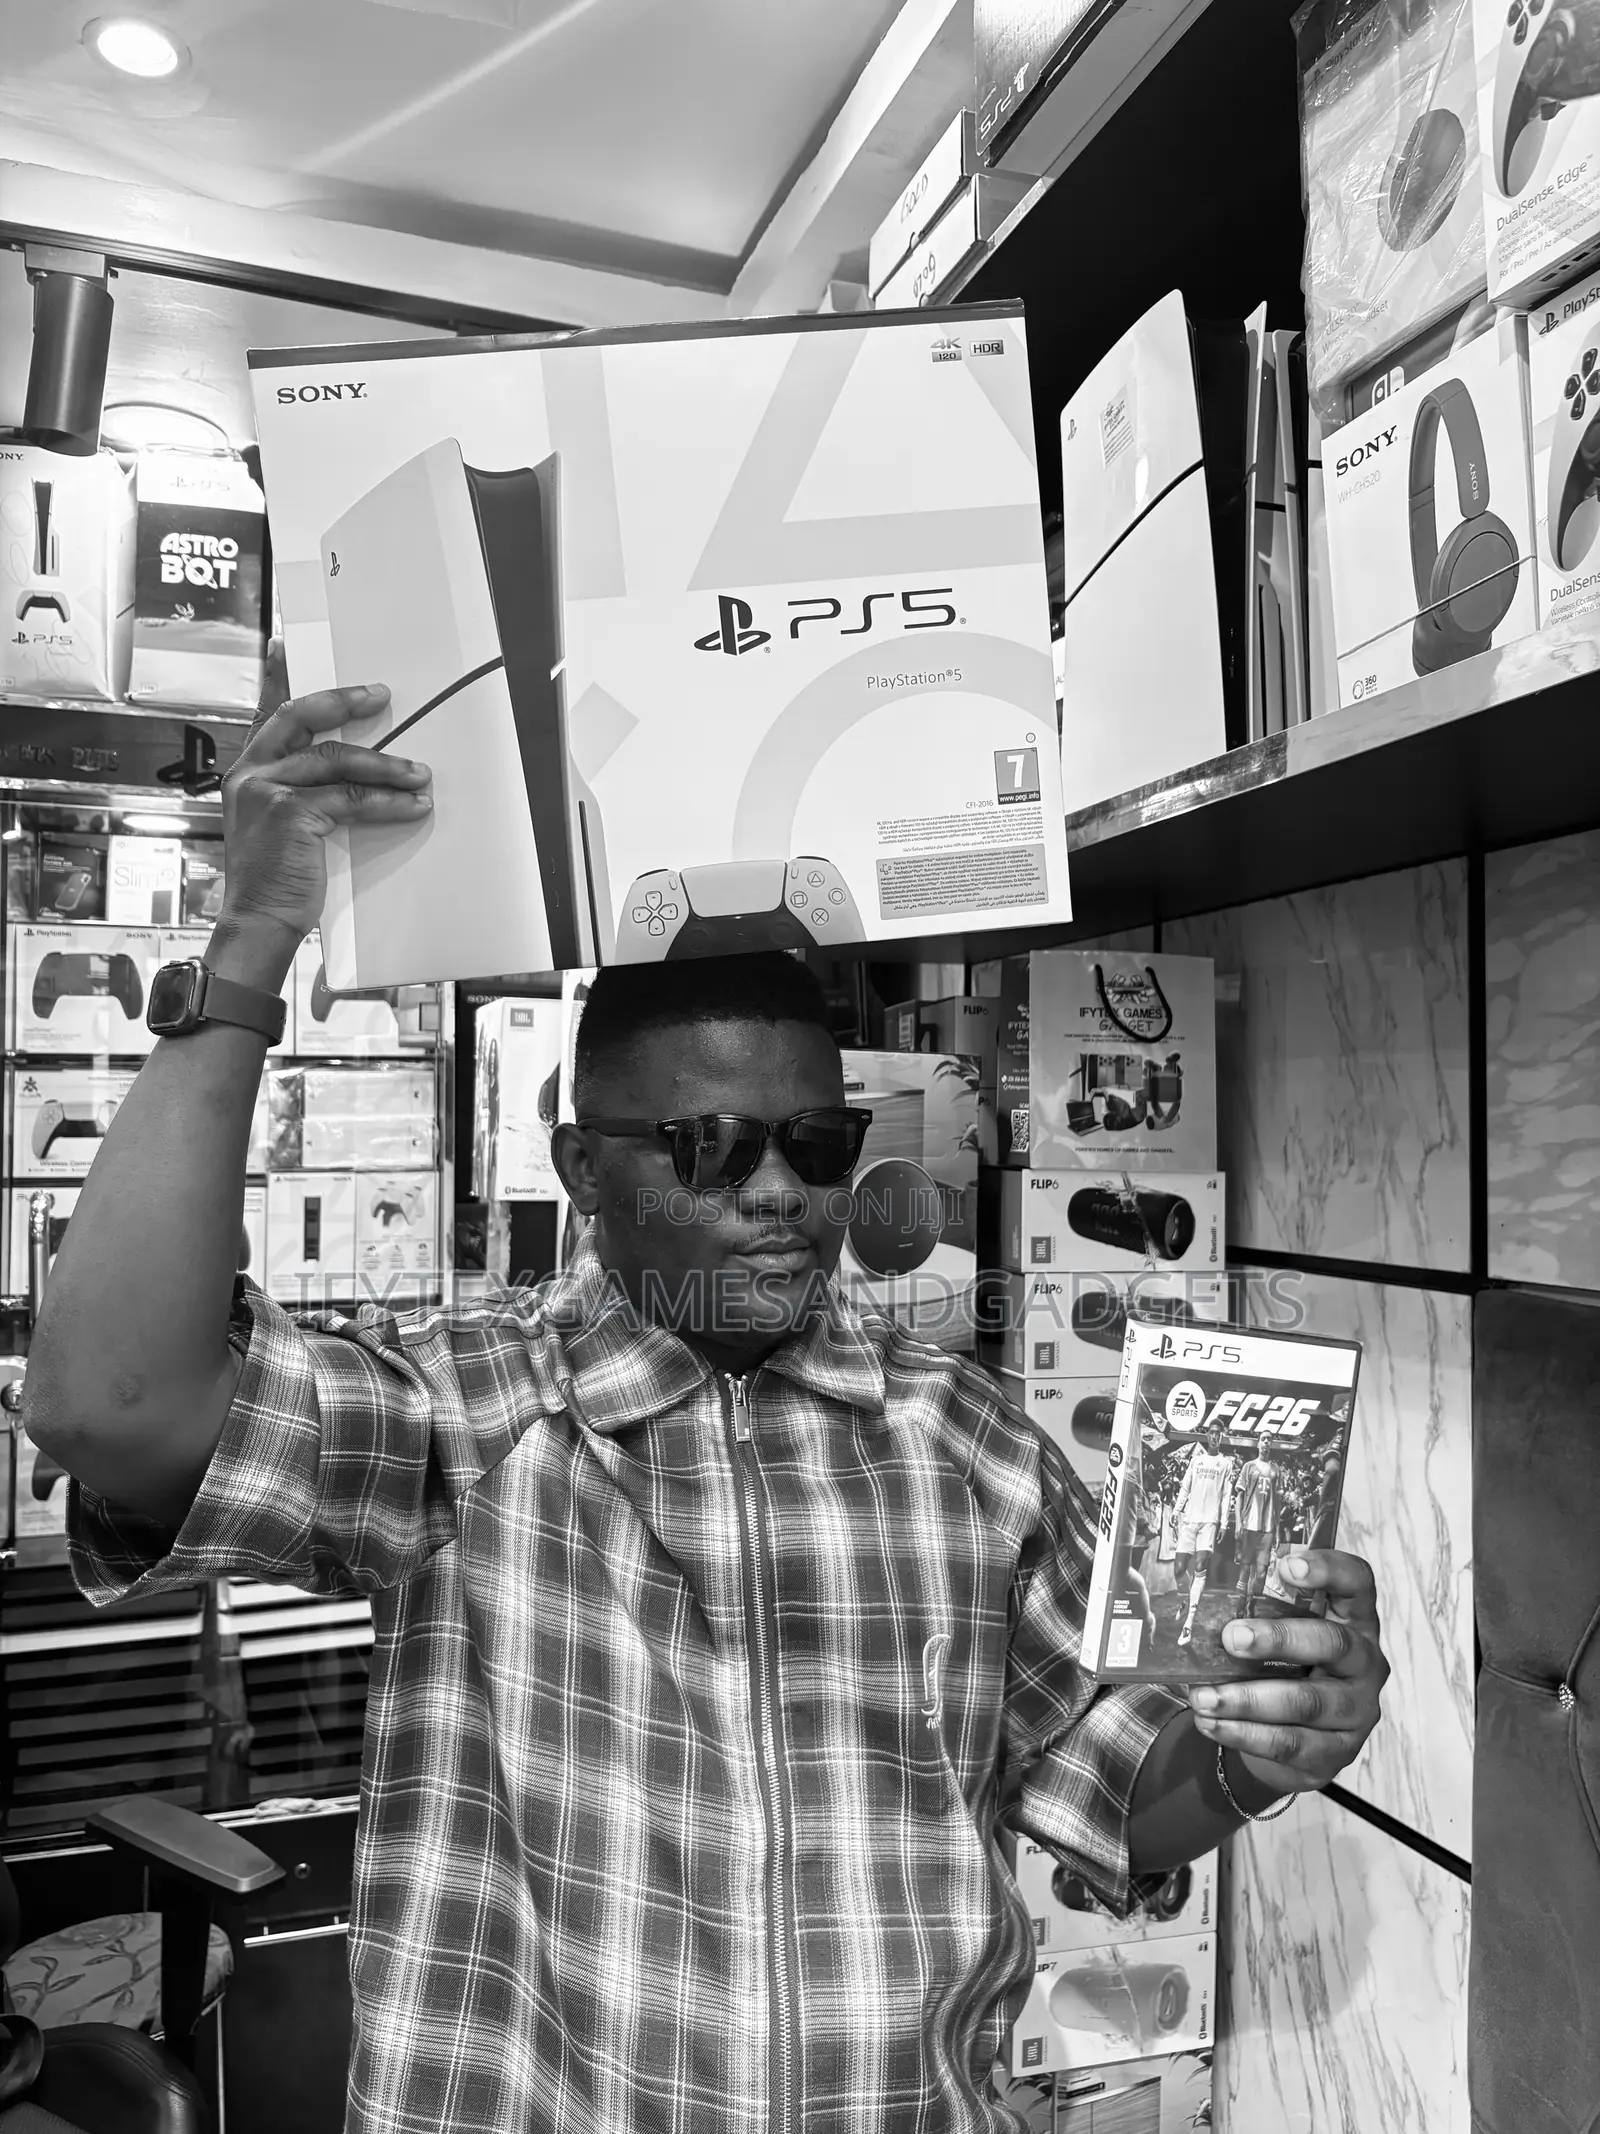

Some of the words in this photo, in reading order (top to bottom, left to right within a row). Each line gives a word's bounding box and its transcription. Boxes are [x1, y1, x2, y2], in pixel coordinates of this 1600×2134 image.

[1496, 184, 1555, 231] DualSense
[1556, 161, 1588, 189] Edge
[1563, 287, 1600, 319] PlaySt
[930, 337, 962, 350] 4K
[973, 342, 1001, 354] HDR
[938, 352, 957, 360] 120
[276, 382, 367, 404] SONY
[0, 452, 24, 460] ONY
[1336, 424, 1398, 478] SONY
[160, 532, 239, 559] ASTRO
[160, 554, 237, 589] BOT
[1365, 674, 1377, 687] 360
[1006, 754, 1026, 788] 7
[999, 792, 1040, 803] www.pegi.info
[965, 800, 994, 809] CFI-2016
[1080, 1007, 1120, 1019] IFYTX
[1123, 1008, 1163, 1019] GAMES
[1098, 1019, 1155, 1032] GAGET
[1031, 1179, 1059, 1190] FLIP6
[1034, 1284, 1063, 1295] FLIP6
[1183, 1340, 1243, 1364] PS5
[1034, 1388, 1063, 1400] FLIP6
[1174, 1392, 1198, 1409] EA
[1171, 1408, 1199, 1419] SPORTS
[1203, 1390, 1321, 1436] FC26
[1100, 1466, 1118, 1543] FC26
[1036, 1961, 1058, 1973] IP7
